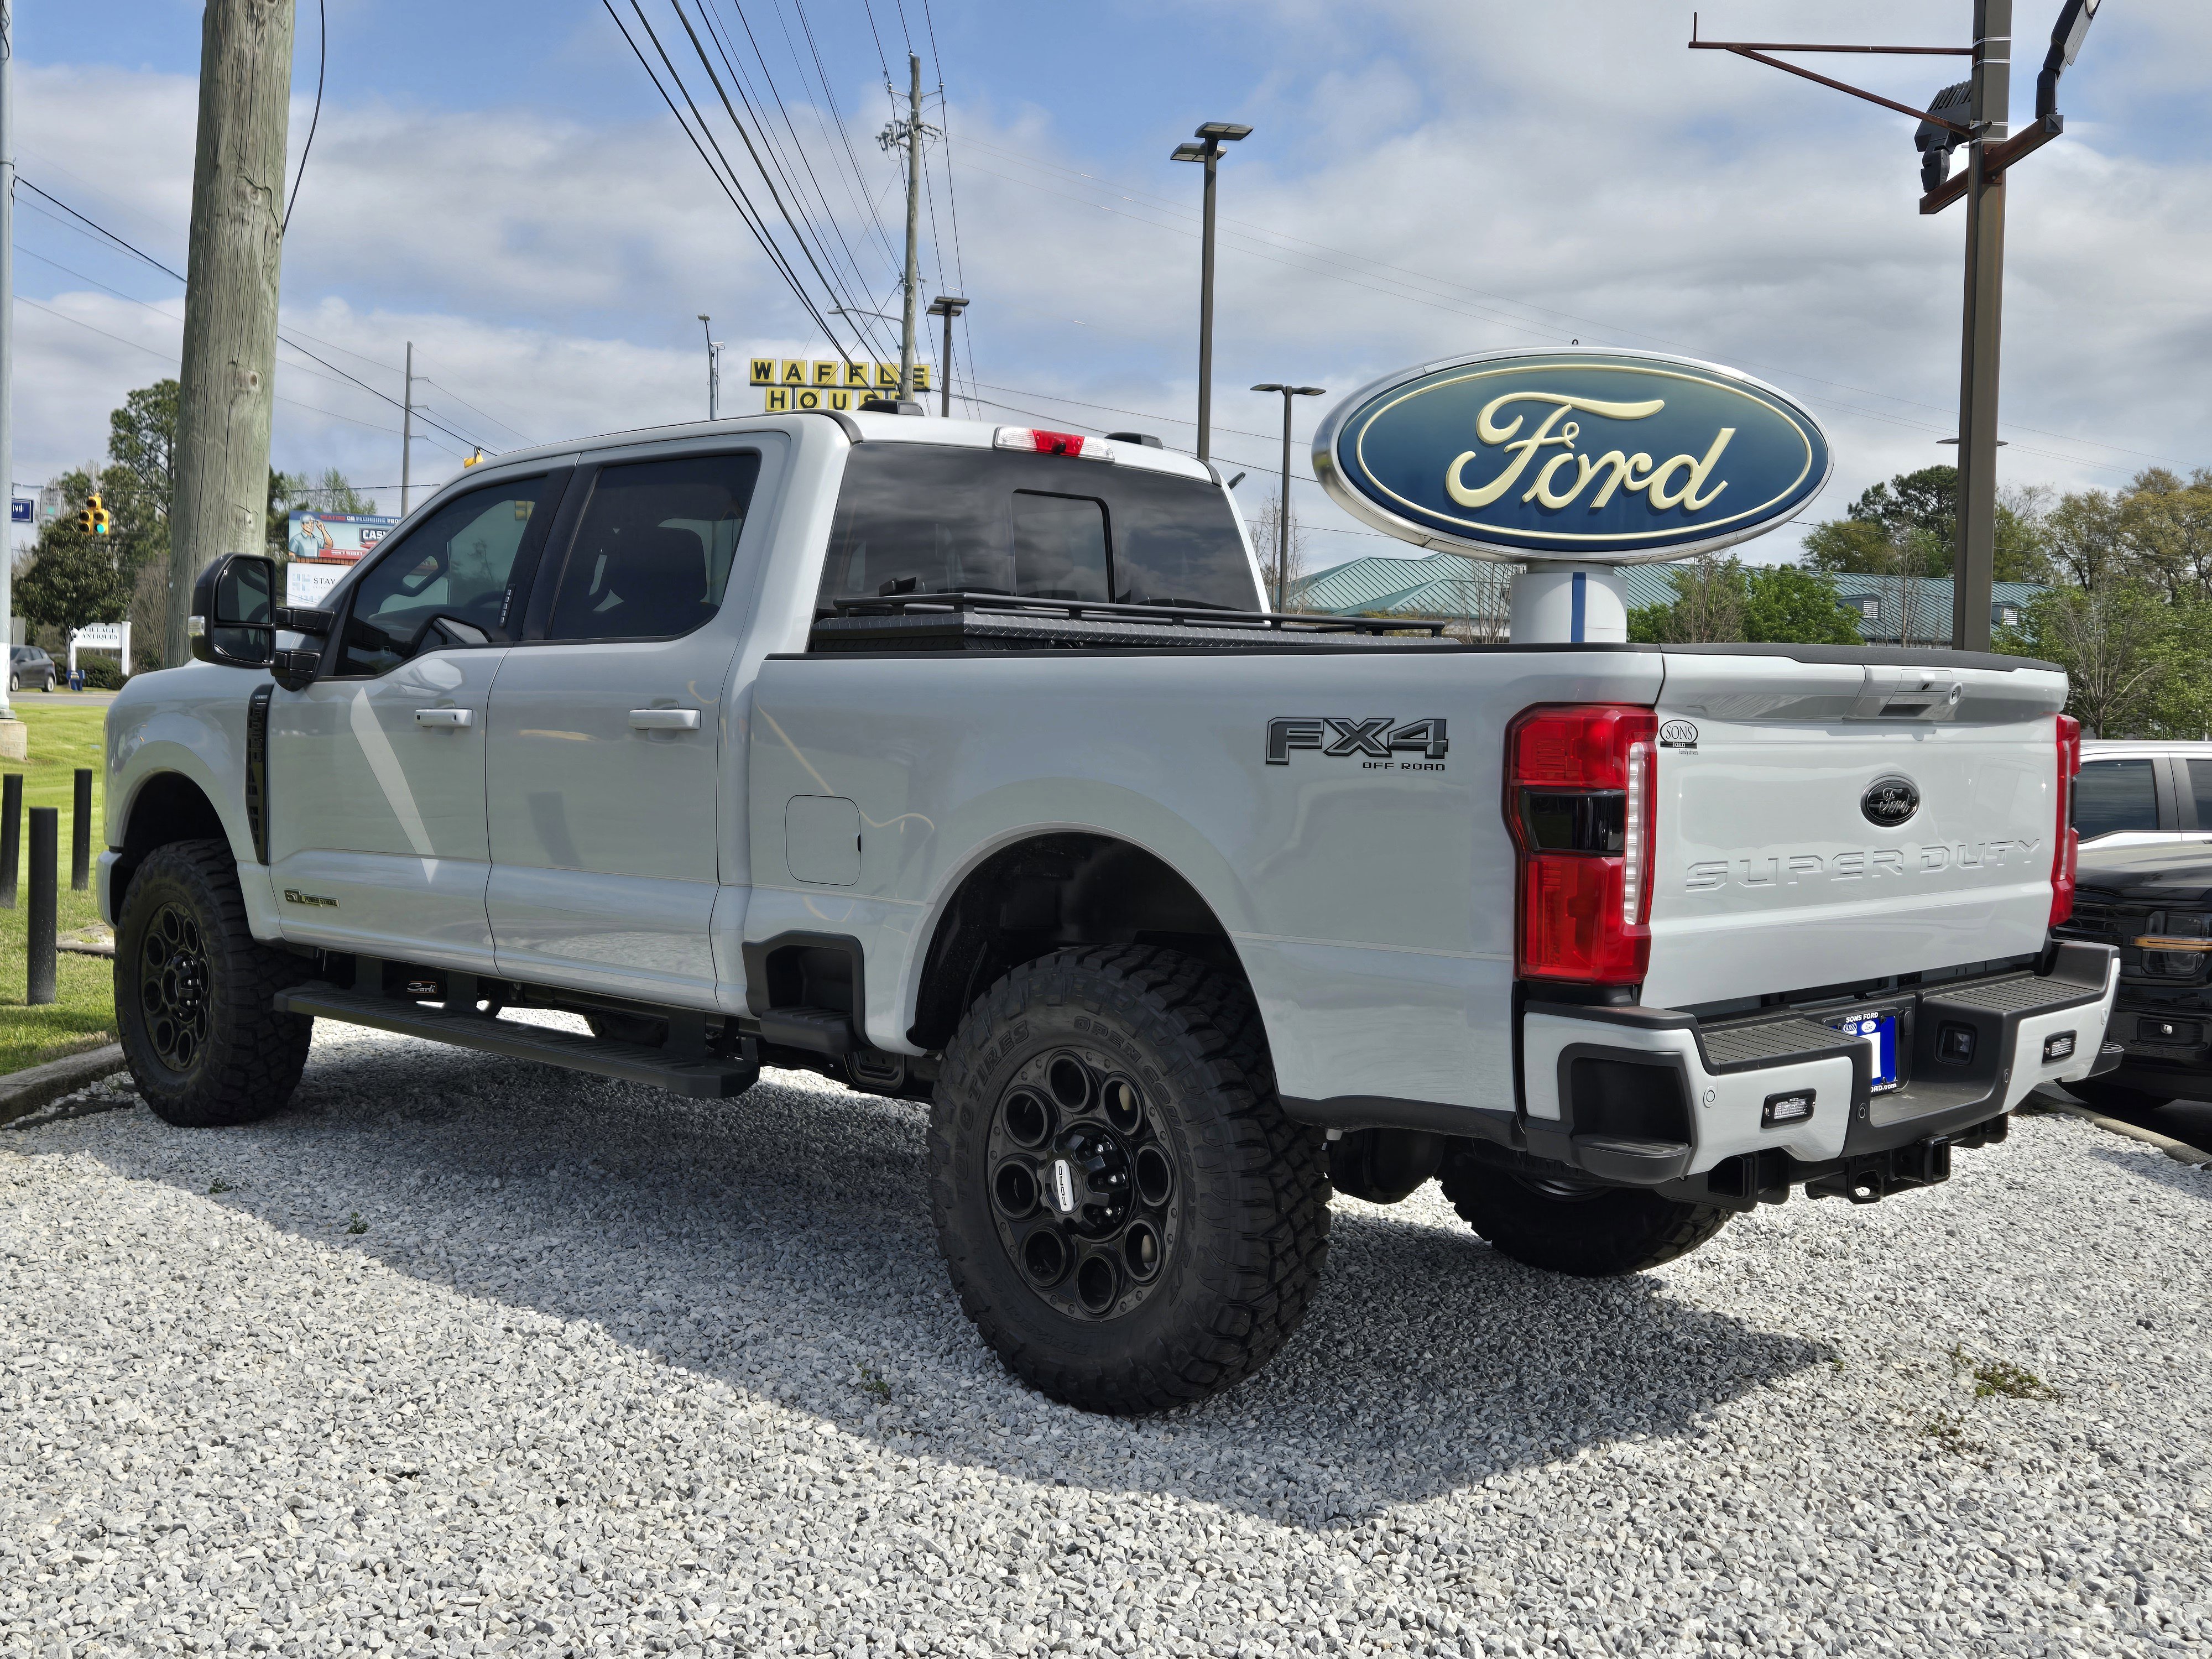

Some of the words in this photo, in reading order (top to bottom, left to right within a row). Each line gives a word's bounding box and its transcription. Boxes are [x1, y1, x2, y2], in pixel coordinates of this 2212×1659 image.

[754, 361, 925, 386] WAFFLE
[770, 390, 900, 410] HOU
[1445, 392, 1736, 511] Ford
[12, 503, 23, 513] lvd
[362, 530, 387, 540] CAS
[1265, 717, 1449, 765] FX4
[1665, 724, 1693, 740] SONS
[1362, 761, 1395, 770] OFF
[1401, 763, 1446, 771] ROAD
[1879, 787, 1910, 814] Ford
[1686, 849, 1903, 893] SUPER
[1919, 838, 2040, 874] DUTY
[1845, 1014, 1863, 1023] SONS
[1863, 1011, 1879, 1020] FORD
[1073, 1015, 1142, 1063] OPEN
[968, 1020, 1030, 1102] TIRES
